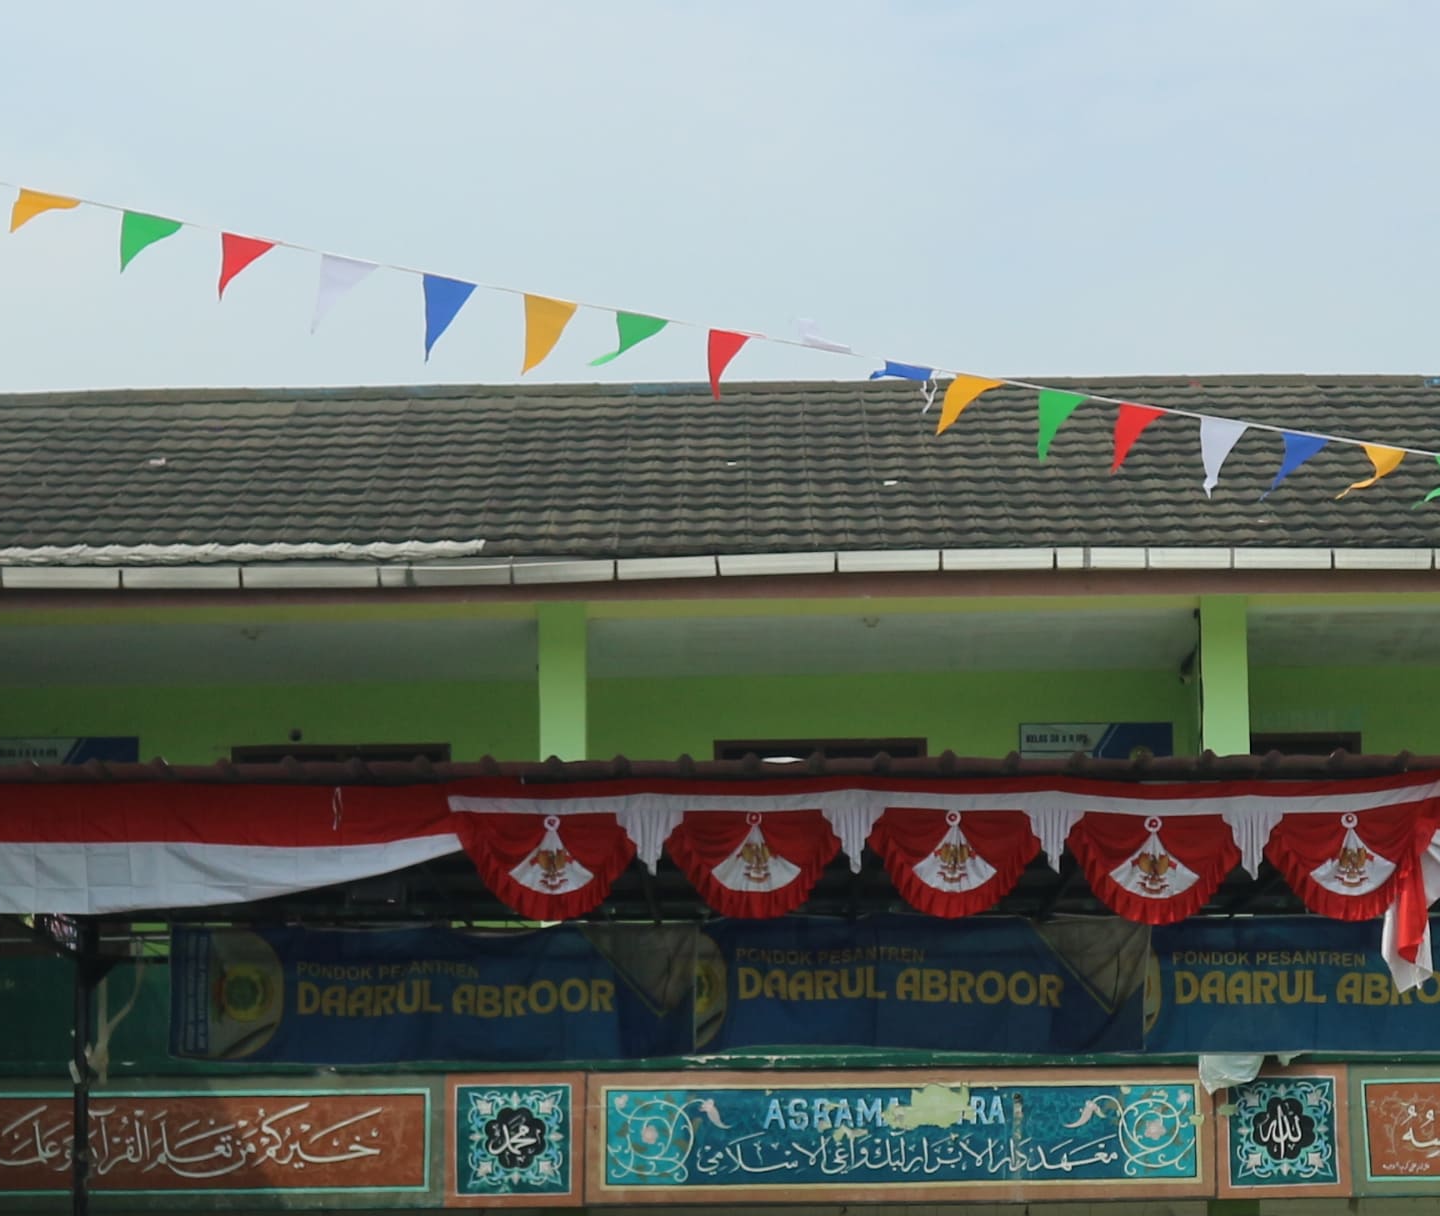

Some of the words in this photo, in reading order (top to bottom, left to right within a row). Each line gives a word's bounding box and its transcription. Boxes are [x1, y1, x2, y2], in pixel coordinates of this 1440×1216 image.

[735, 946, 810, 965] PONDOK
[1171, 951, 1250, 967] PONDOK
[1256, 951, 1366, 968] PESANTREN
[296, 961, 372, 981] PONDOK
[296, 979, 444, 1018] DAARUL
[452, 978, 616, 1019] ABROOR
[737, 966, 888, 1002] DAARUL
[895, 968, 1066, 1009] ABROOR
[1173, 970, 1327, 1006] DAARUL
